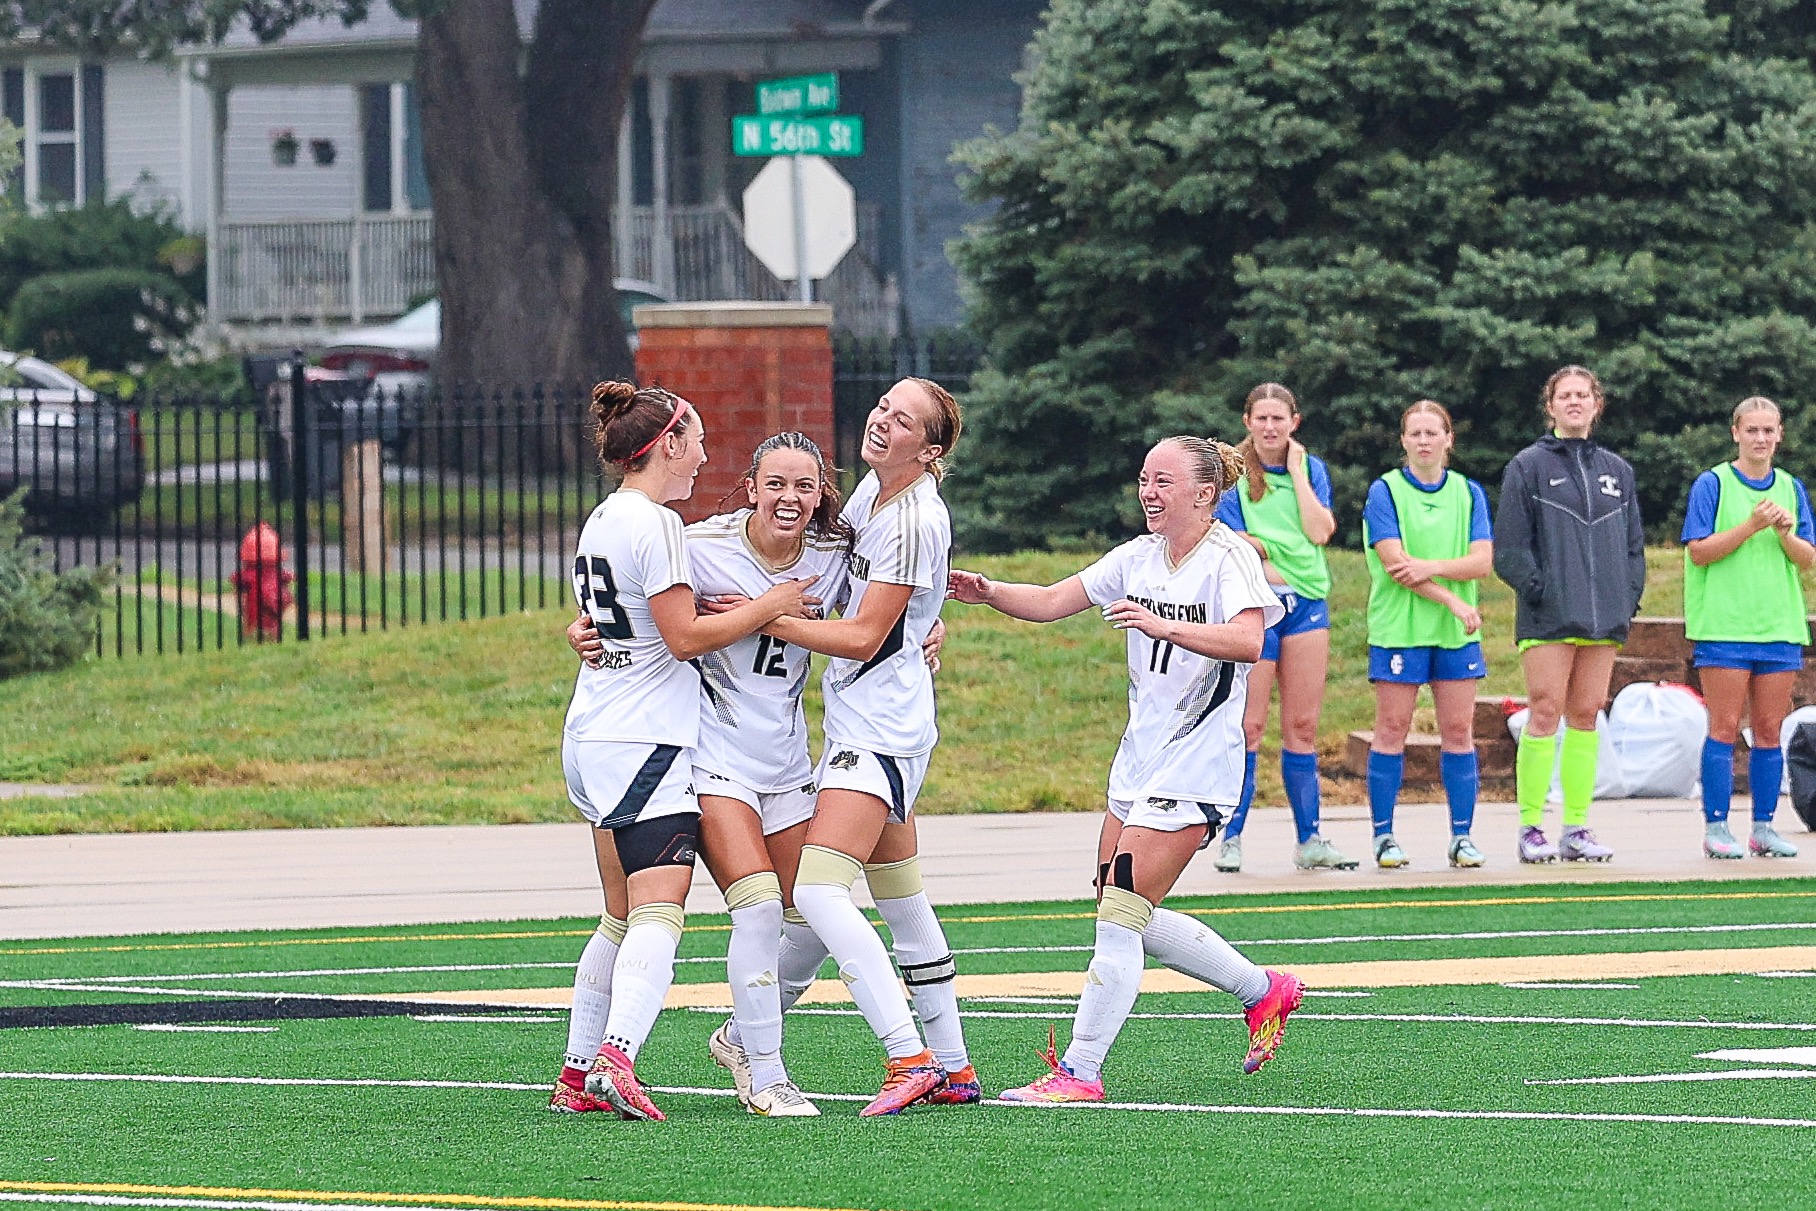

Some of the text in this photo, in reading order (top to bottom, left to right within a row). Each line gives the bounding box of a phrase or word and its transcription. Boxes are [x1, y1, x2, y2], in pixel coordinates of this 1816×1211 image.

[743, 121, 852, 151] N 56th St
[751, 633, 788, 679] 12
